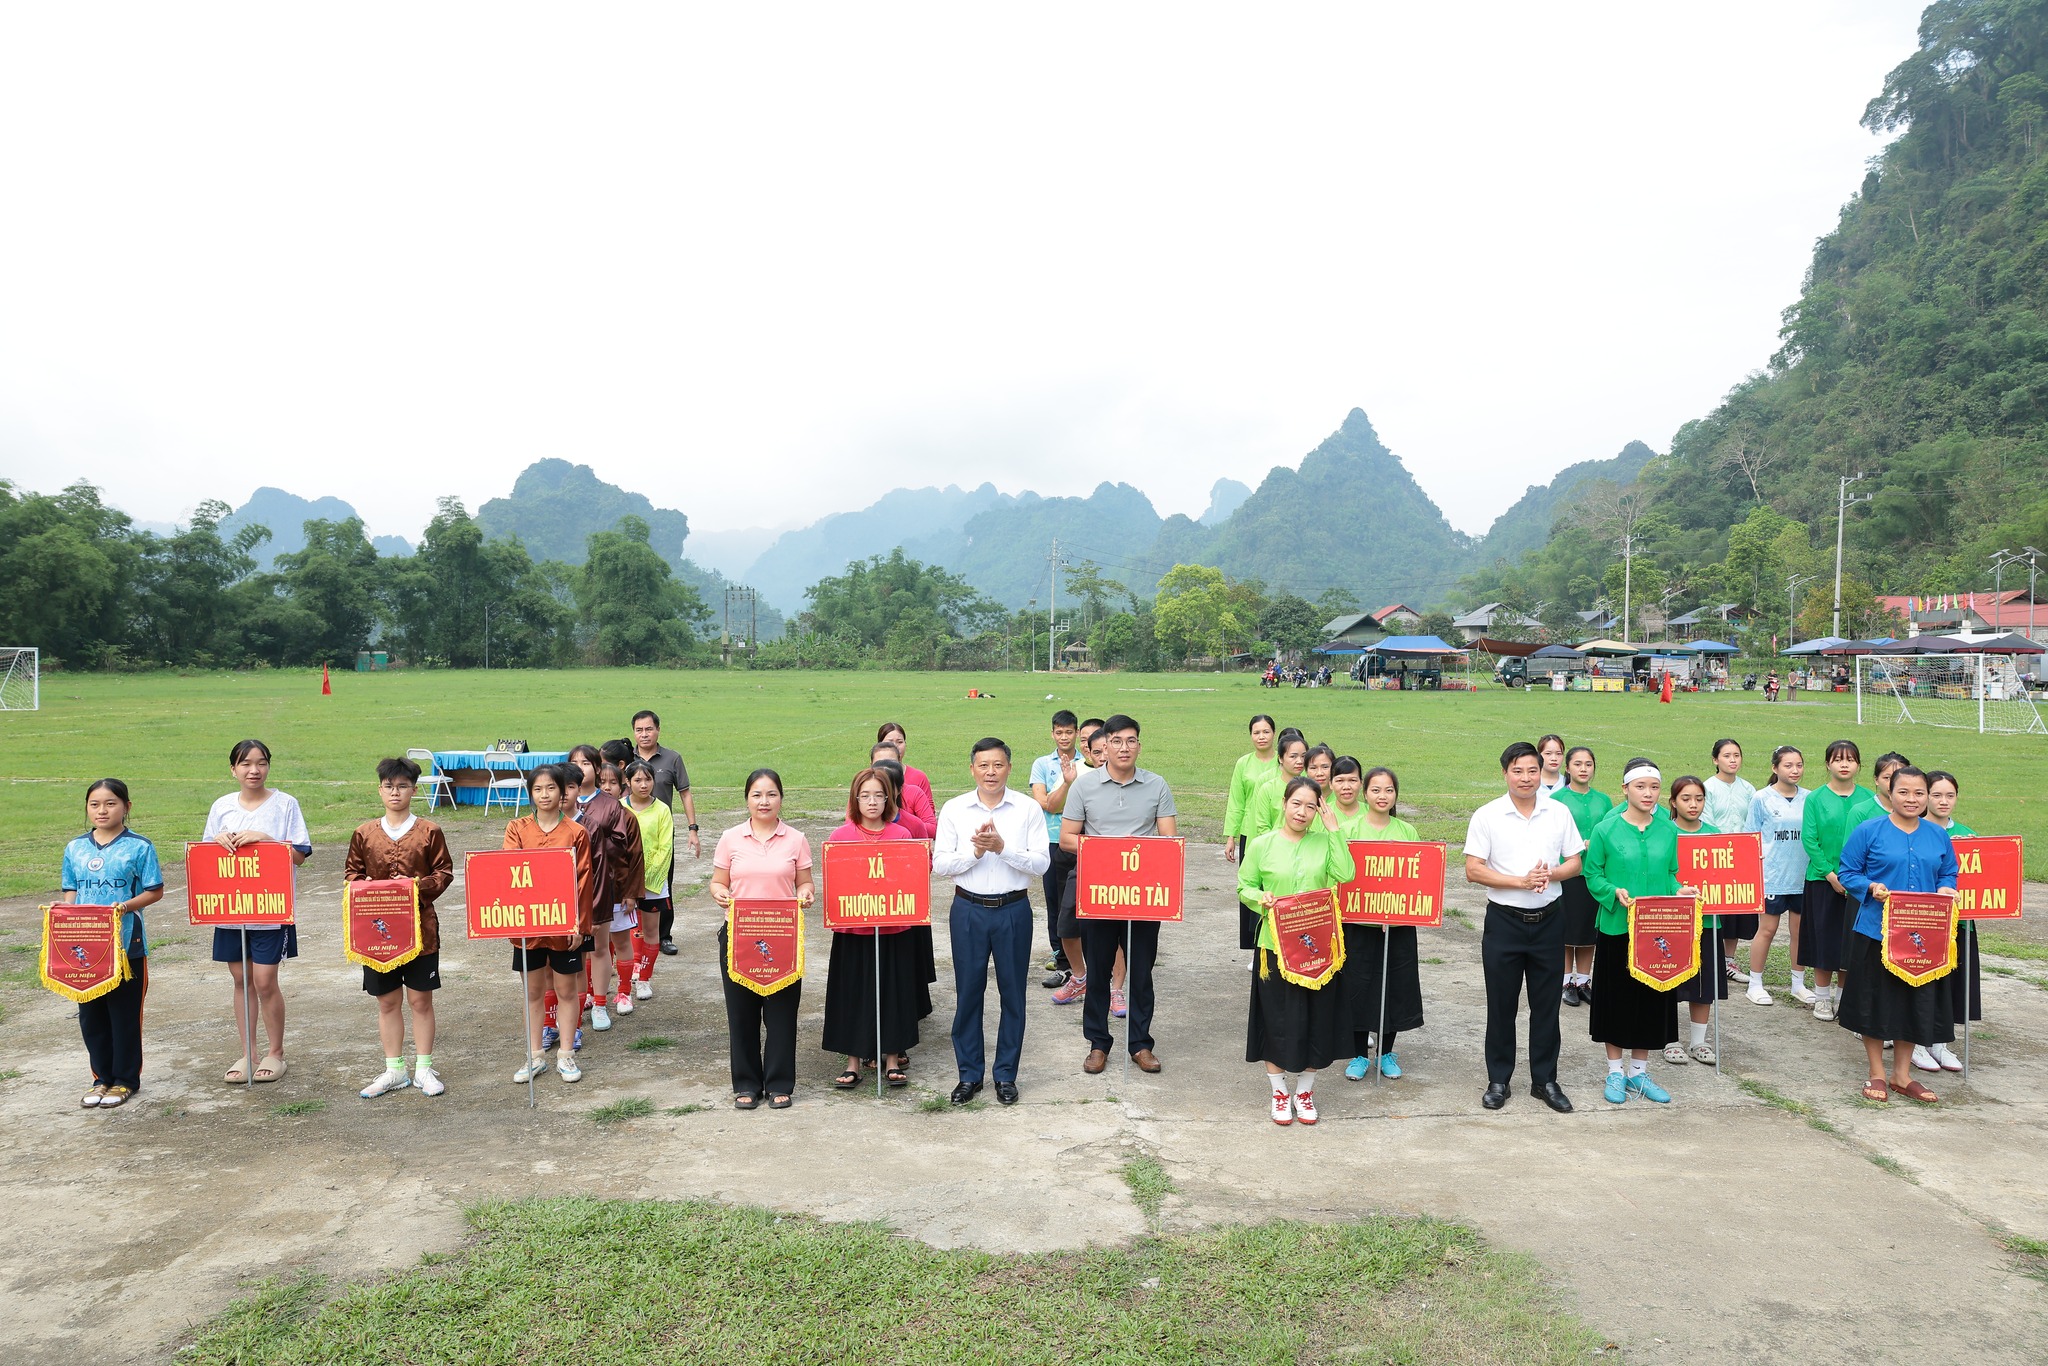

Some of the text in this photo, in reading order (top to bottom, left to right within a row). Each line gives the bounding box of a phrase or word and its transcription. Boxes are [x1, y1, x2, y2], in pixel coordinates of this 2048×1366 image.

[515, 743, 522, 752] 0
[218, 849, 260, 878] NỮ TRẺ
[868, 852, 885, 879] XÃ
[1120, 844, 1141, 872] TỔ
[1364, 851, 1422, 882] TRẠM Y TẾ
[1692, 840, 1735, 870] FC TRẺ
[1958, 848, 1983, 874] XÃ
[76, 879, 127, 889] TIHAD
[510, 861, 533, 889] XÃ
[195, 888, 286, 915] THPT LÂM BÌNH
[838, 889, 916, 922] THƯỢNG LÂM
[1089, 882, 1170, 910] TRỌNG TÀI
[1345, 887, 1361, 913] XÃ
[1364, 891, 1406, 919] THƯỢNG
[1408, 890, 1433, 917] LÂM
[1694, 879, 1755, 905] ÂM BÌNH
[1980, 888, 2006, 910] AN
[480, 898, 567, 929] HỒNG THÁI
